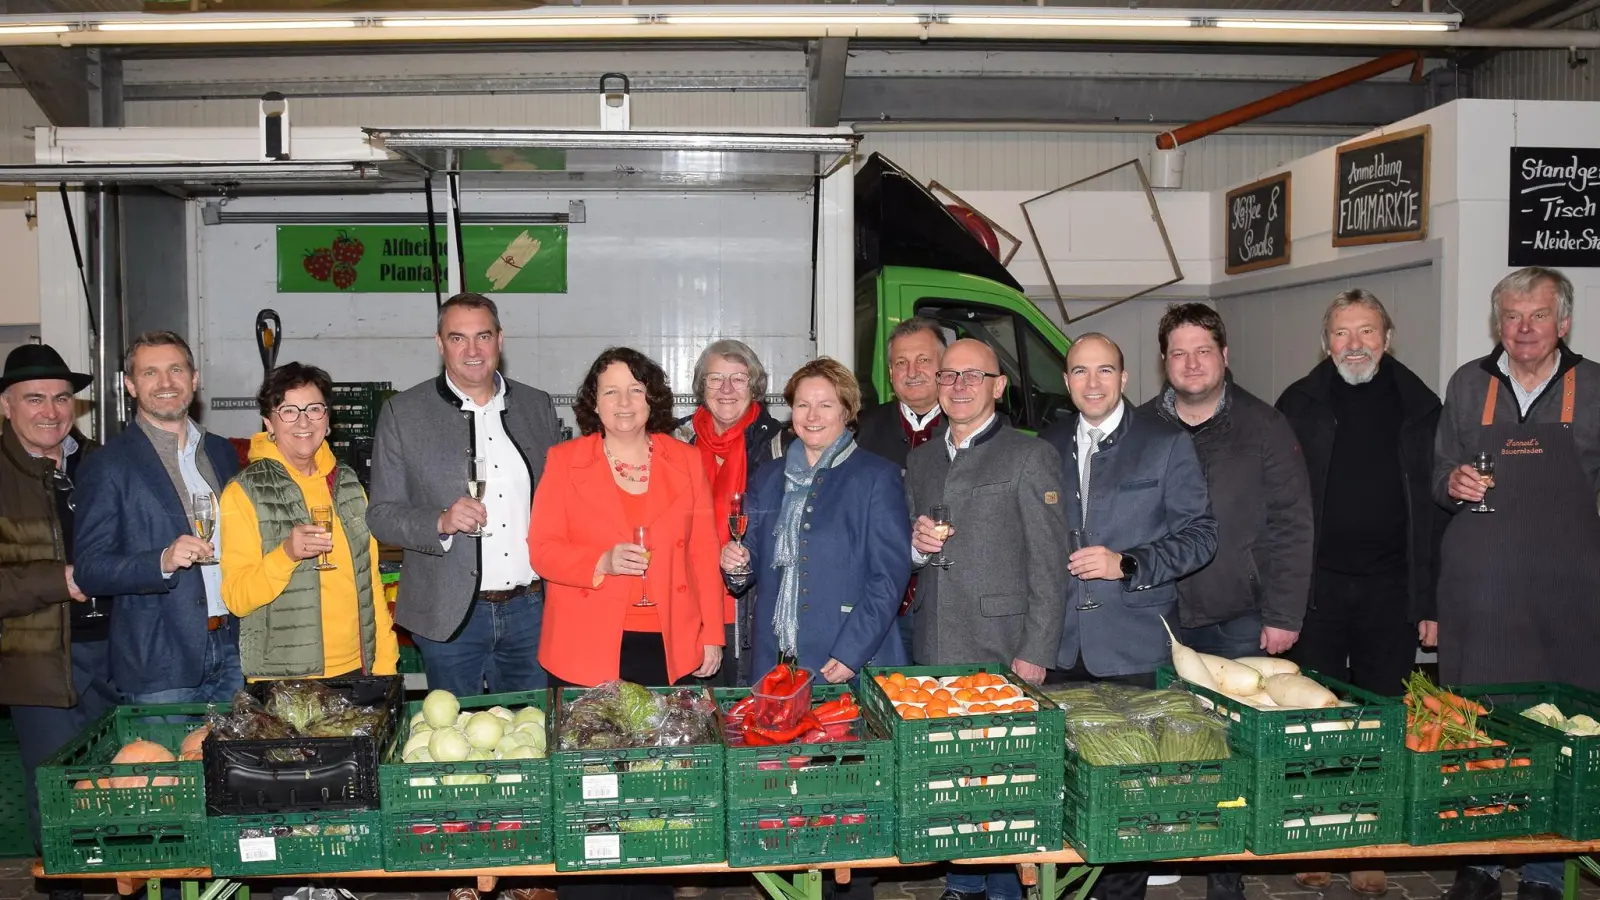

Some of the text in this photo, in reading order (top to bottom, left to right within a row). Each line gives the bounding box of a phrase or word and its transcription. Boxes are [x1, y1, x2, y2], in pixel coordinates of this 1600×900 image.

[1348, 152, 1402, 187] Anmeldung
[1521, 155, 1600, 192] Standge
[1268, 185, 1280, 222] &
[1339, 188, 1419, 234] FLOHMÄRKTE
[1540, 195, 1596, 221] Tisch
[1238, 222, 1274, 262] Snacks
